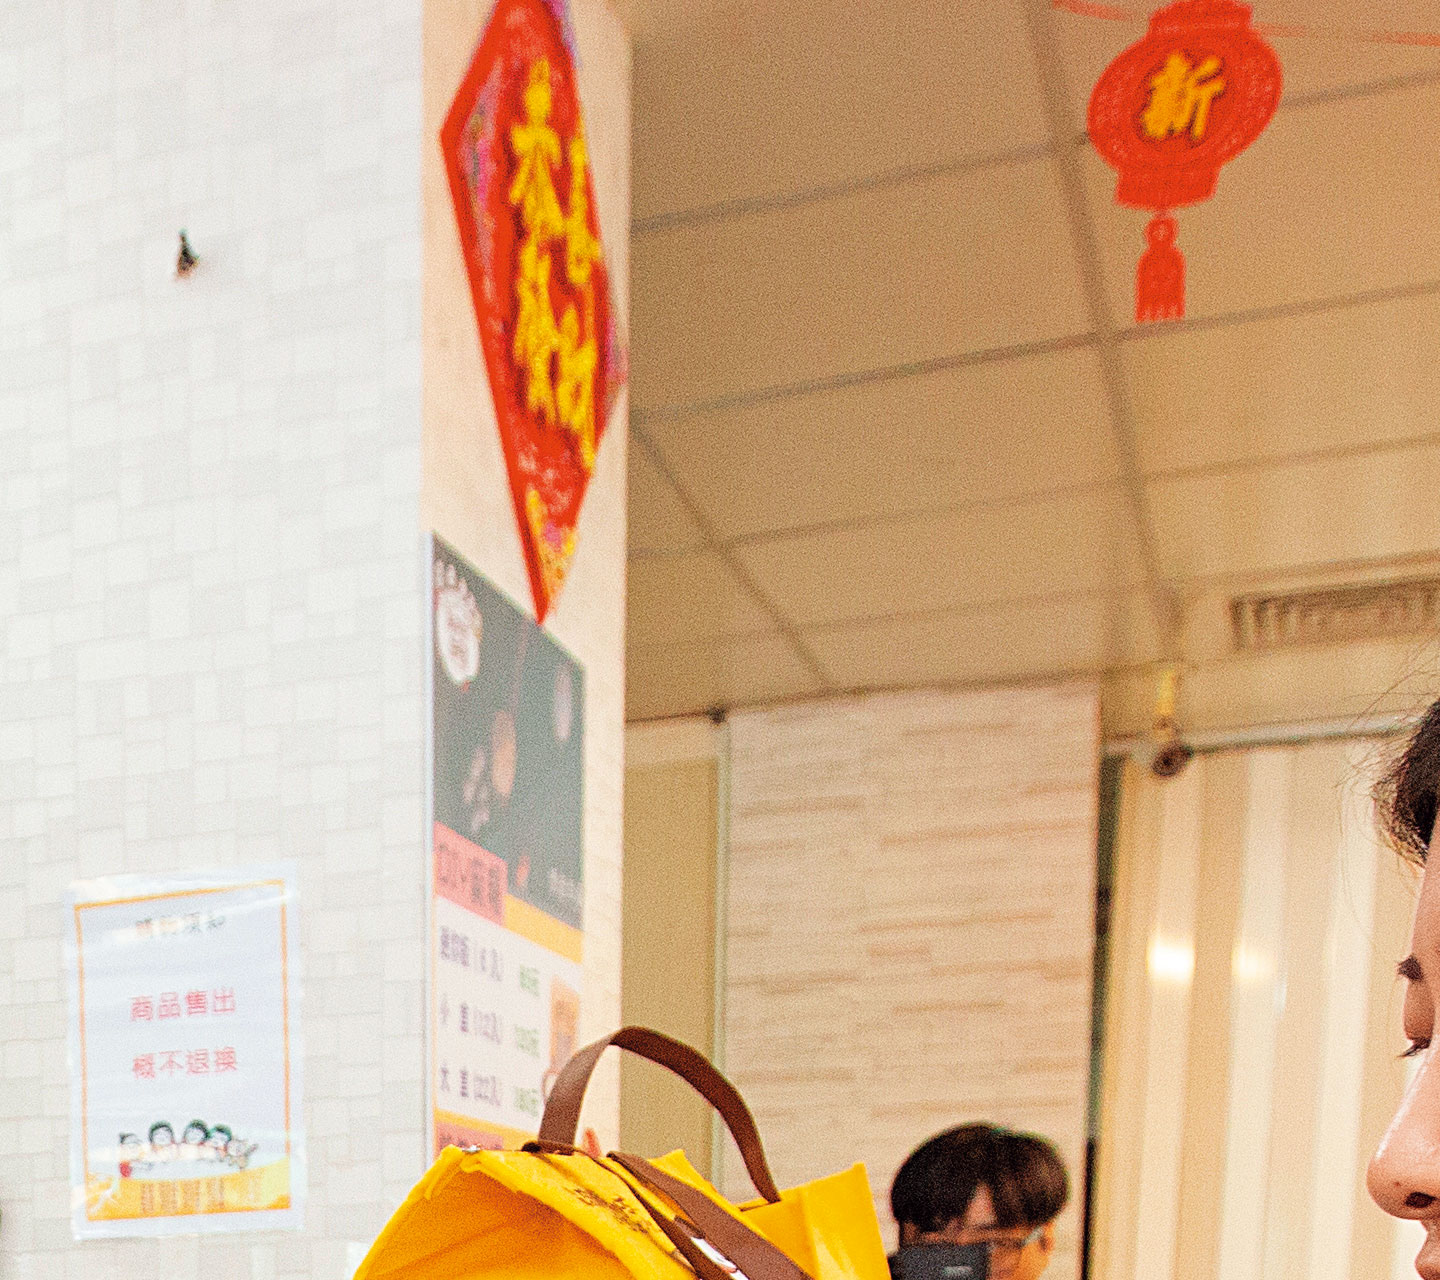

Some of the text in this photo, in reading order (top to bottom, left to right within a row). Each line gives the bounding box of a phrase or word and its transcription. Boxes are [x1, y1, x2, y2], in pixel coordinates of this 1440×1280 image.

[1143, 52, 1225, 140] 新
[130, 987, 236, 1021] 商品售出
[132, 1046, 238, 1079] 概不退換
